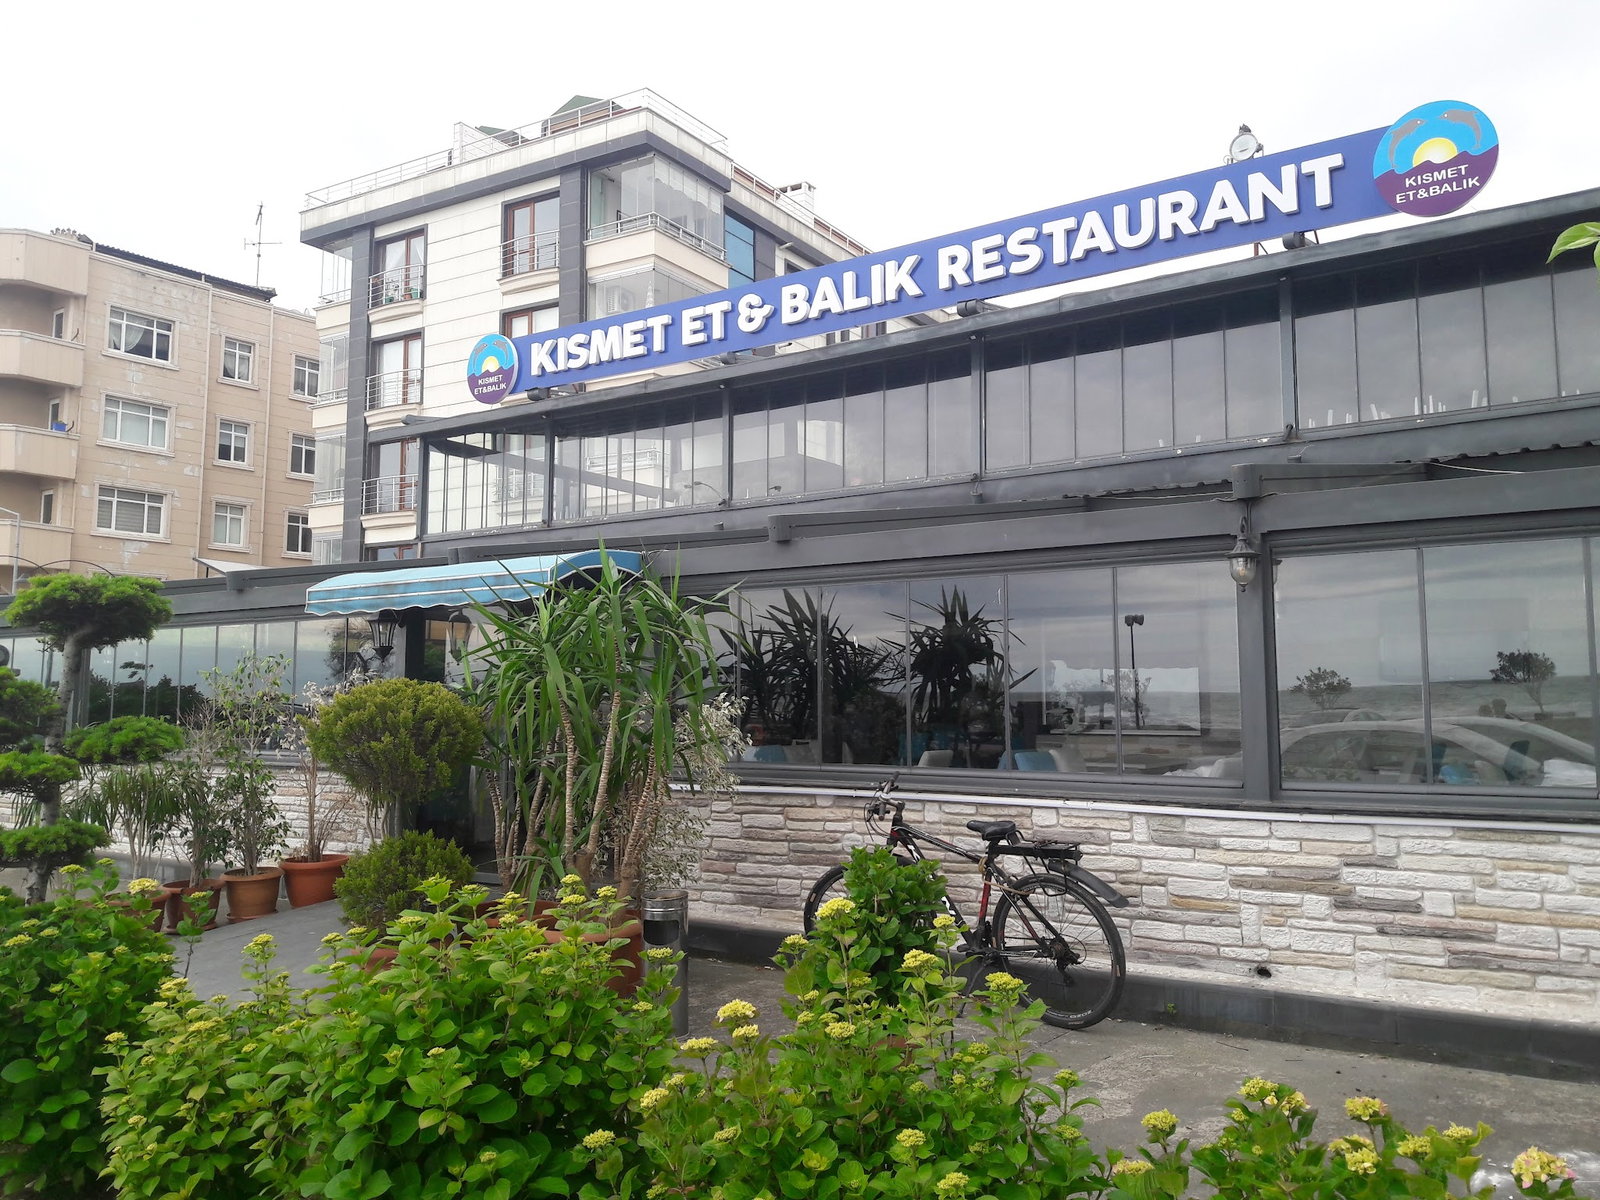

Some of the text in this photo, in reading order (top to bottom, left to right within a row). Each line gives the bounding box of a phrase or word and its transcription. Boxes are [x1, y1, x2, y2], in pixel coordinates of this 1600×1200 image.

[1405, 164, 1469, 188] KISMET
[1395, 176, 1480, 204] ET&BALIK
[530, 152, 1345, 377] KISMET ET & BALIK RESTAURANT
[474, 382, 507, 395] ET&BALIK
[478, 374, 503, 386] KISMET
